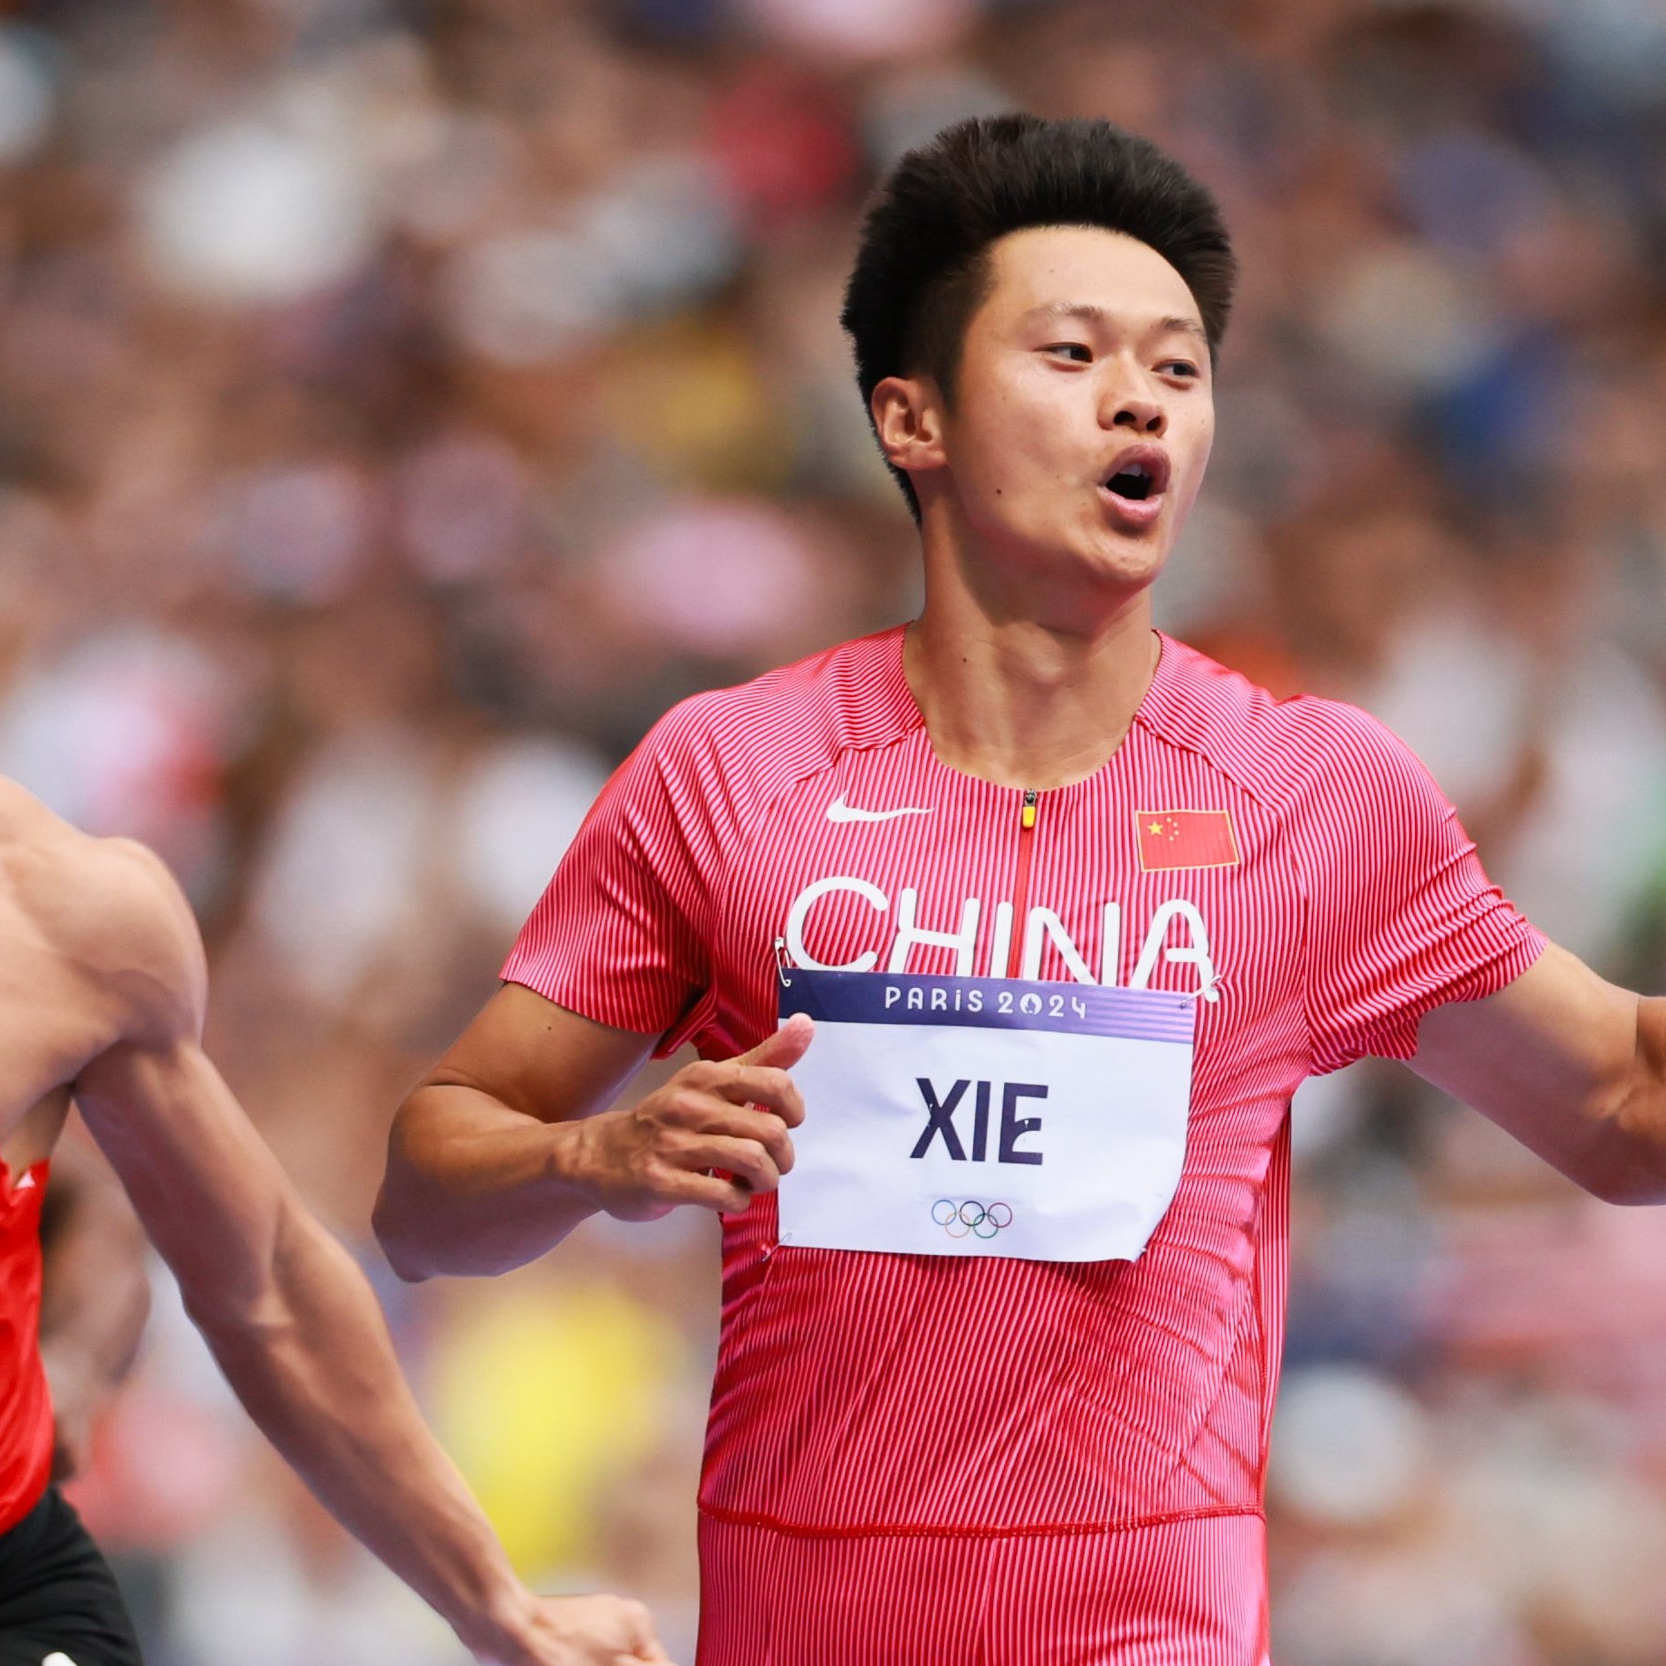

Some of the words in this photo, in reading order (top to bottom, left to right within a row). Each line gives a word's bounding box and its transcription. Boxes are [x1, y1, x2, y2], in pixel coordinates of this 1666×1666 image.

[787, 876, 1220, 1002] CHINA
[885, 986, 984, 1013] PARIS
[997, 991, 1087, 1020] 2024
[909, 1077, 1049, 1166] XIE
